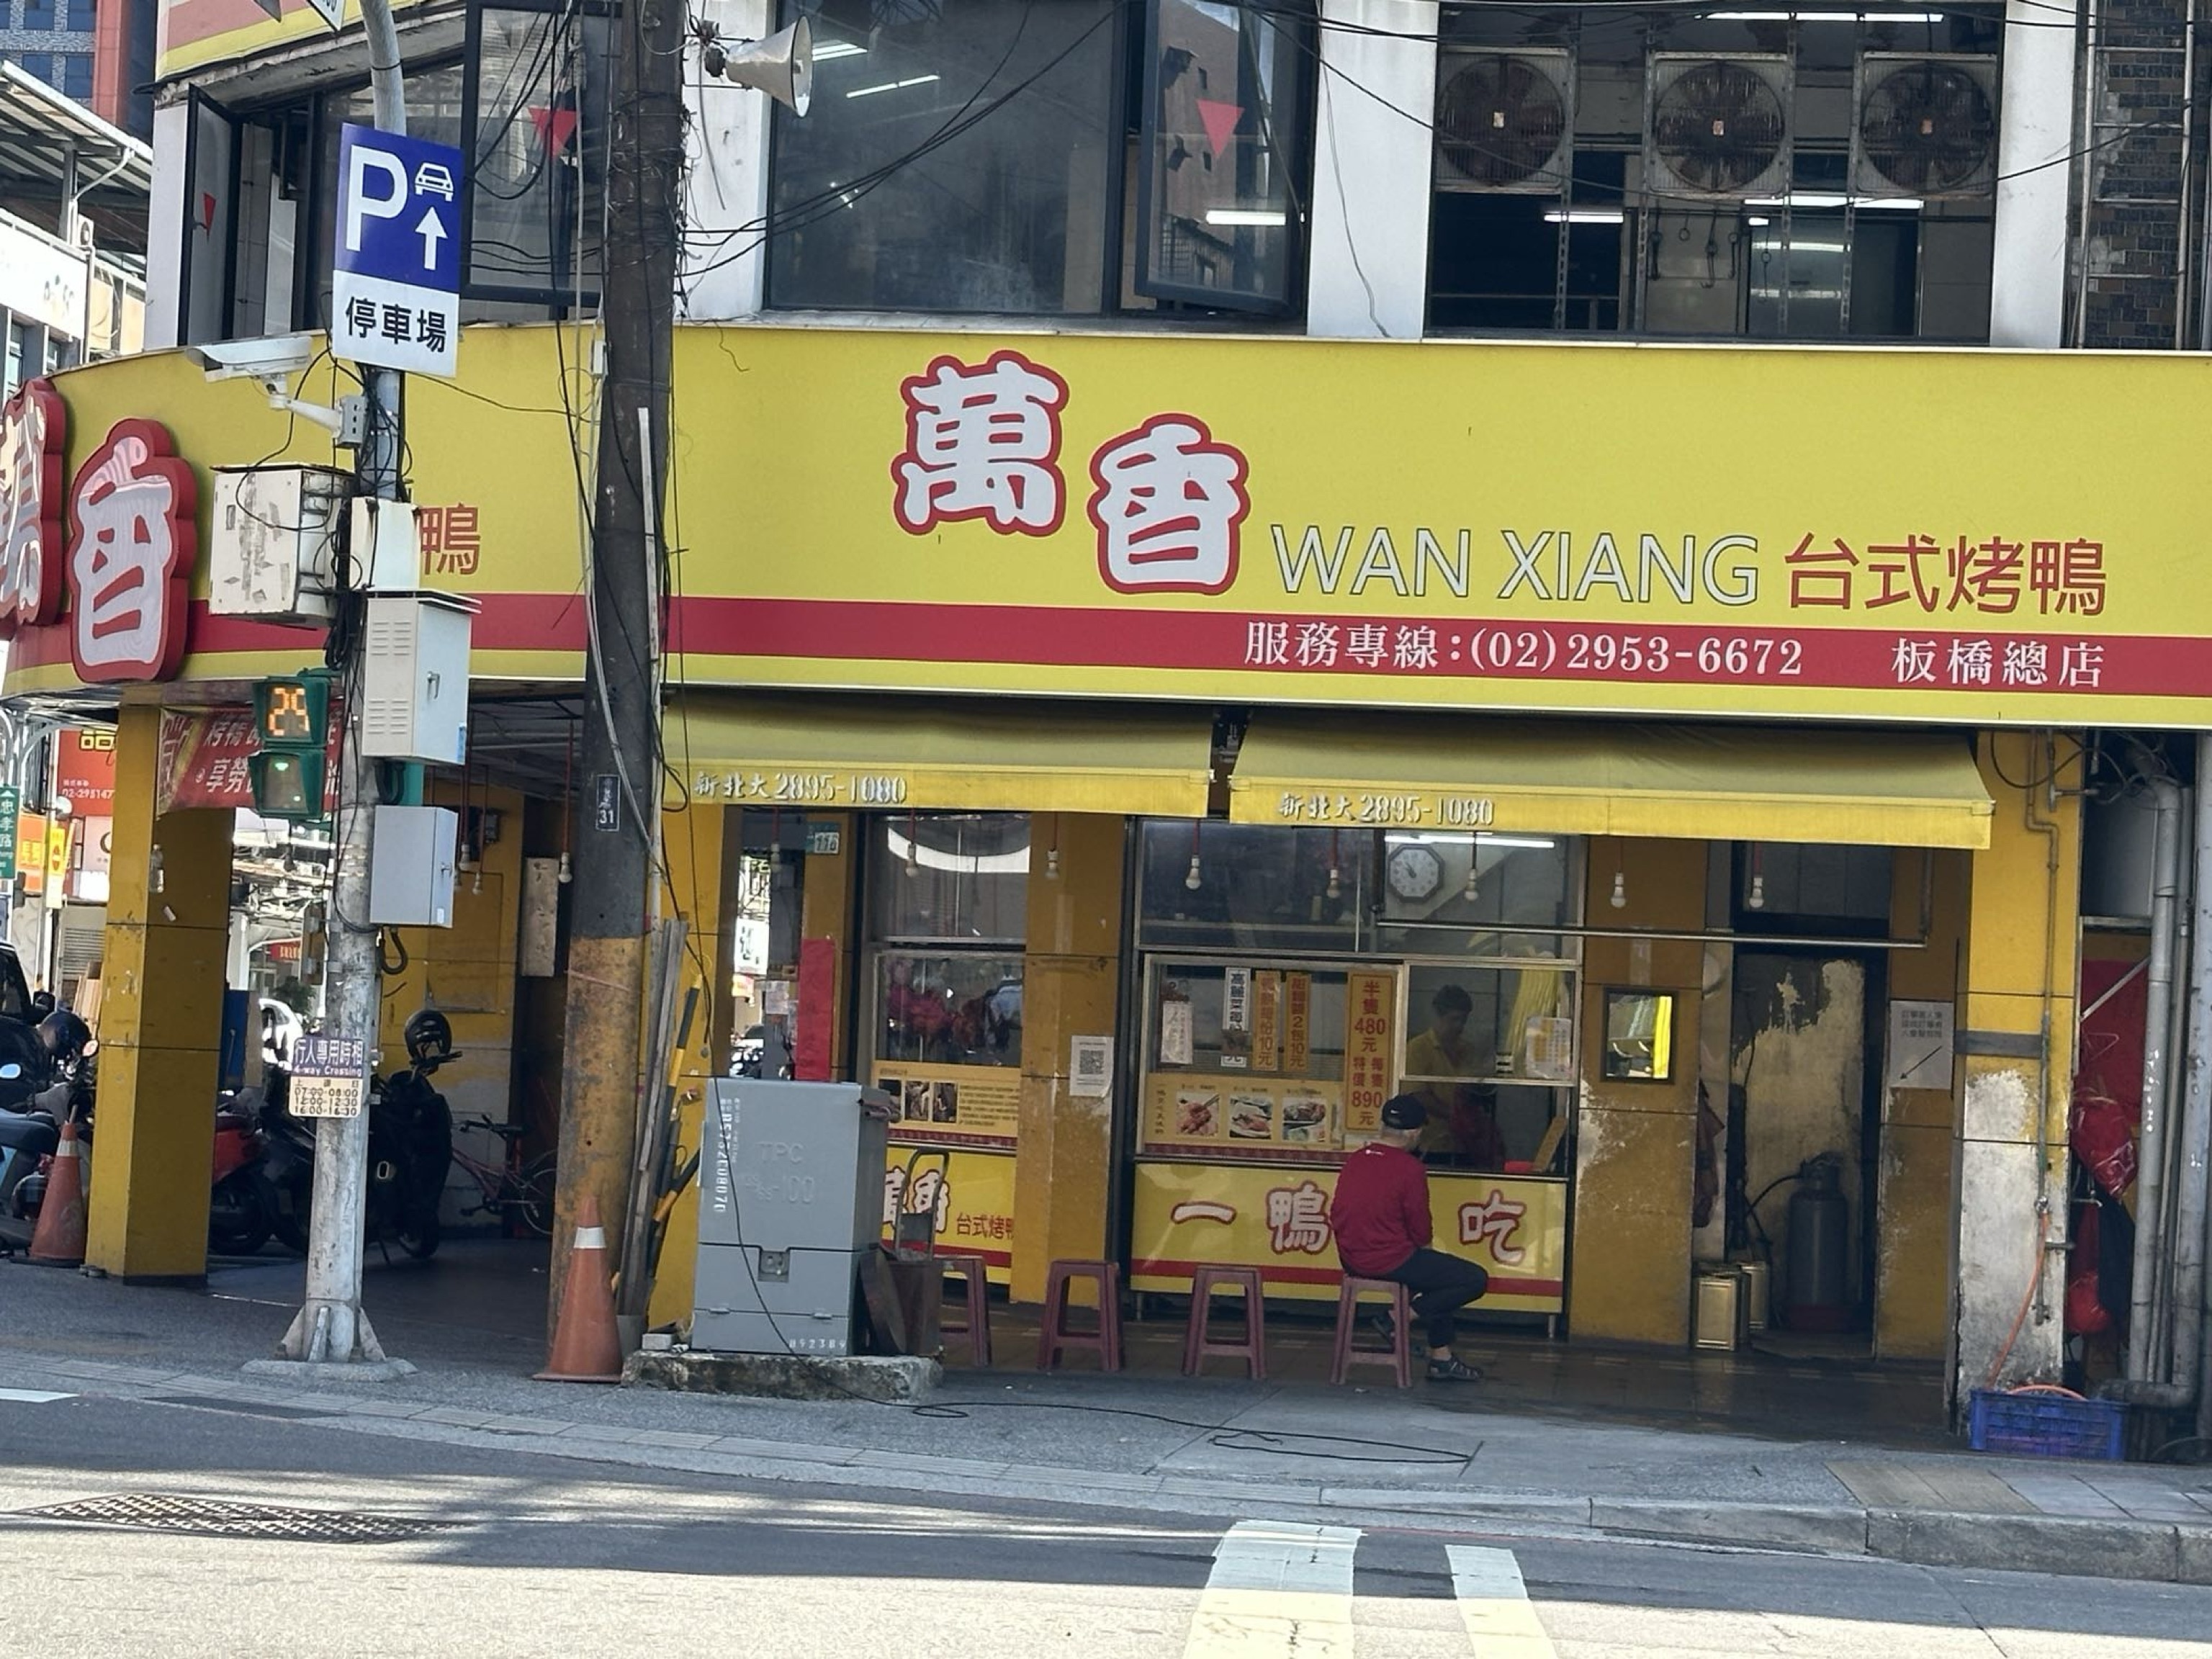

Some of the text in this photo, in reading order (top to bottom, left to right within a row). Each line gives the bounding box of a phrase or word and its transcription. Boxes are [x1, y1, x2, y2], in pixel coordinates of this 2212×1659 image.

[346, 144, 408, 251] P
[345, 297, 446, 353] 停車場
[891, 350, 1251, 595] 萬香
[421, 502, 481, 575] 鴨
[1271, 523, 1759, 606] WAN XIANG
[1784, 532, 2107, 617] 台式烤鴨
[1891, 637, 2105, 688] 板橋總店
[295, 1039, 363, 1066] 行人專用時相
